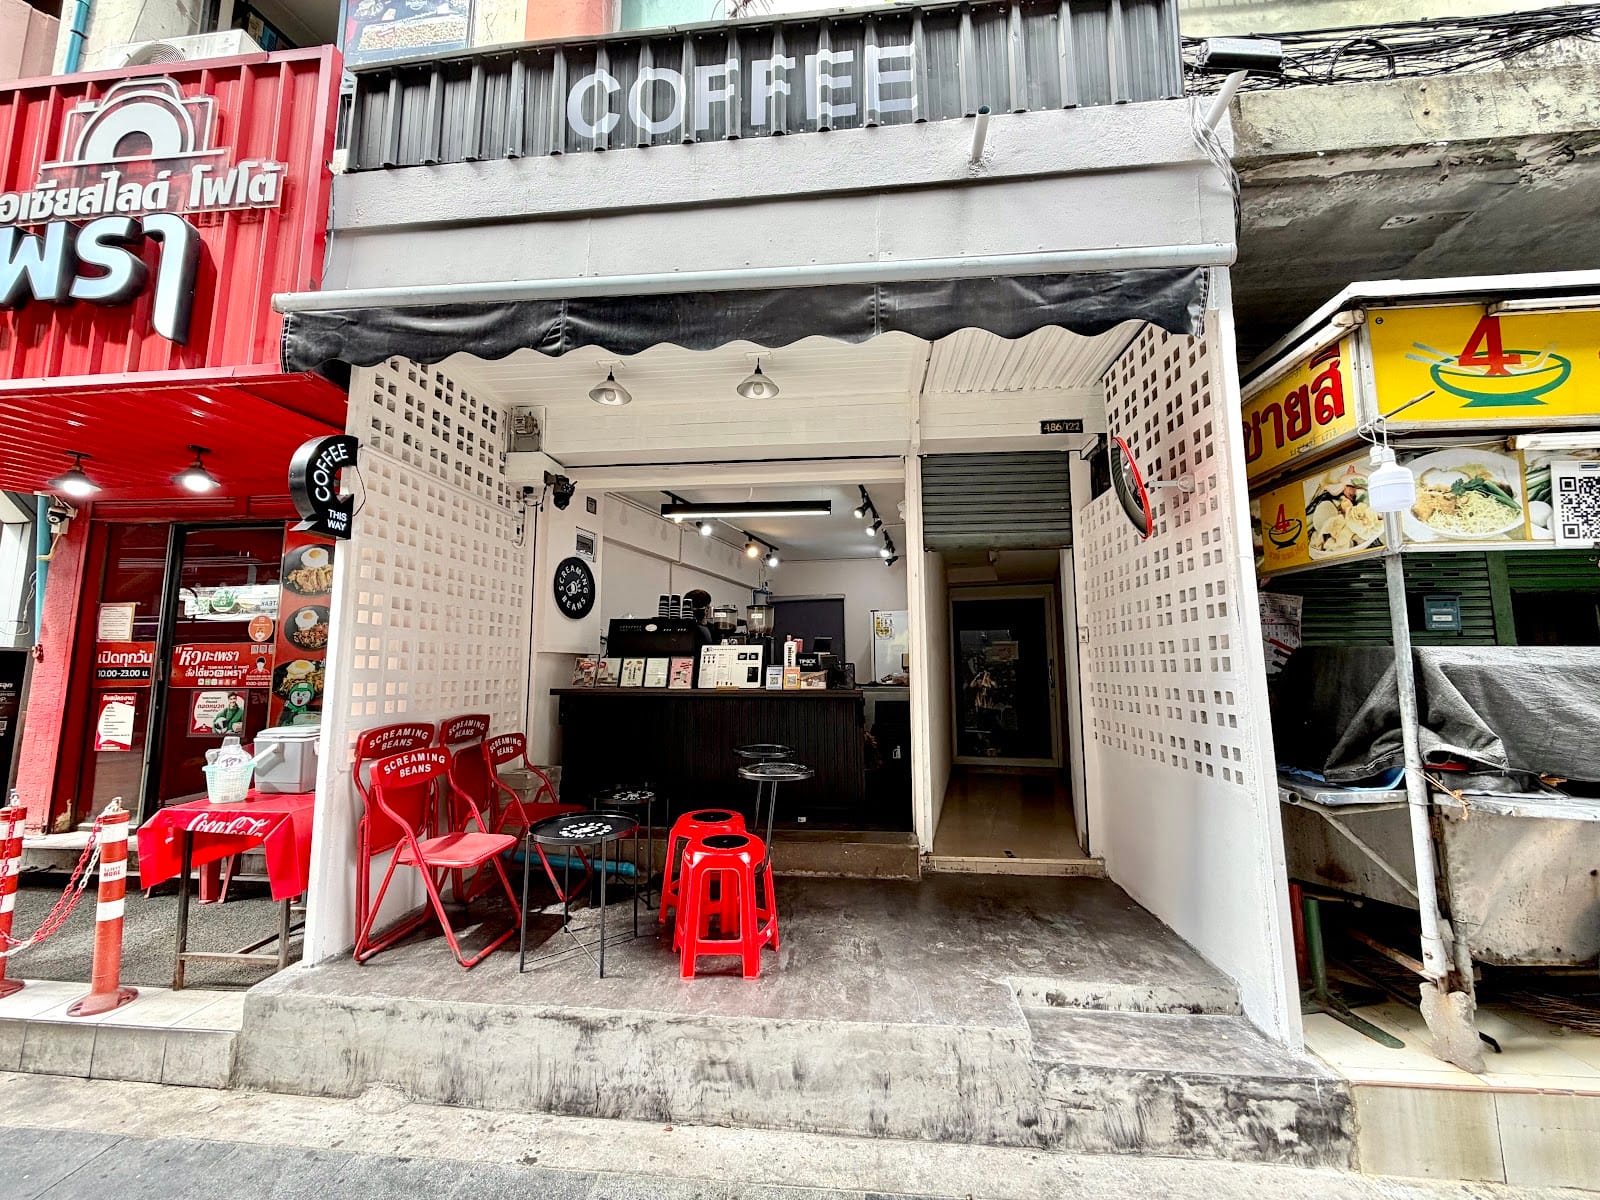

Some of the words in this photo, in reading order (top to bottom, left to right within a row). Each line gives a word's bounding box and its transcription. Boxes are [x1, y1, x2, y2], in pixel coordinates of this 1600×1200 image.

[567, 41, 918, 138] COFFEE
[313, 443, 349, 502] COFFEE
[327, 508, 347, 521] THIS
[327, 519, 347, 531] WAY
[558, 564, 589, 594] SCREAMING
[561, 595, 586, 611] BEANS
[97, 649, 153, 667] เปิดทุกวัน
[448, 718, 486, 736] SCREAMING
[454, 728, 474, 739] BEANS
[369, 727, 430, 748] SCREAMING
[381, 738, 414, 751] BEANS
[383, 752, 446, 775] SCREAMING
[399, 763, 432, 778] BEANS
